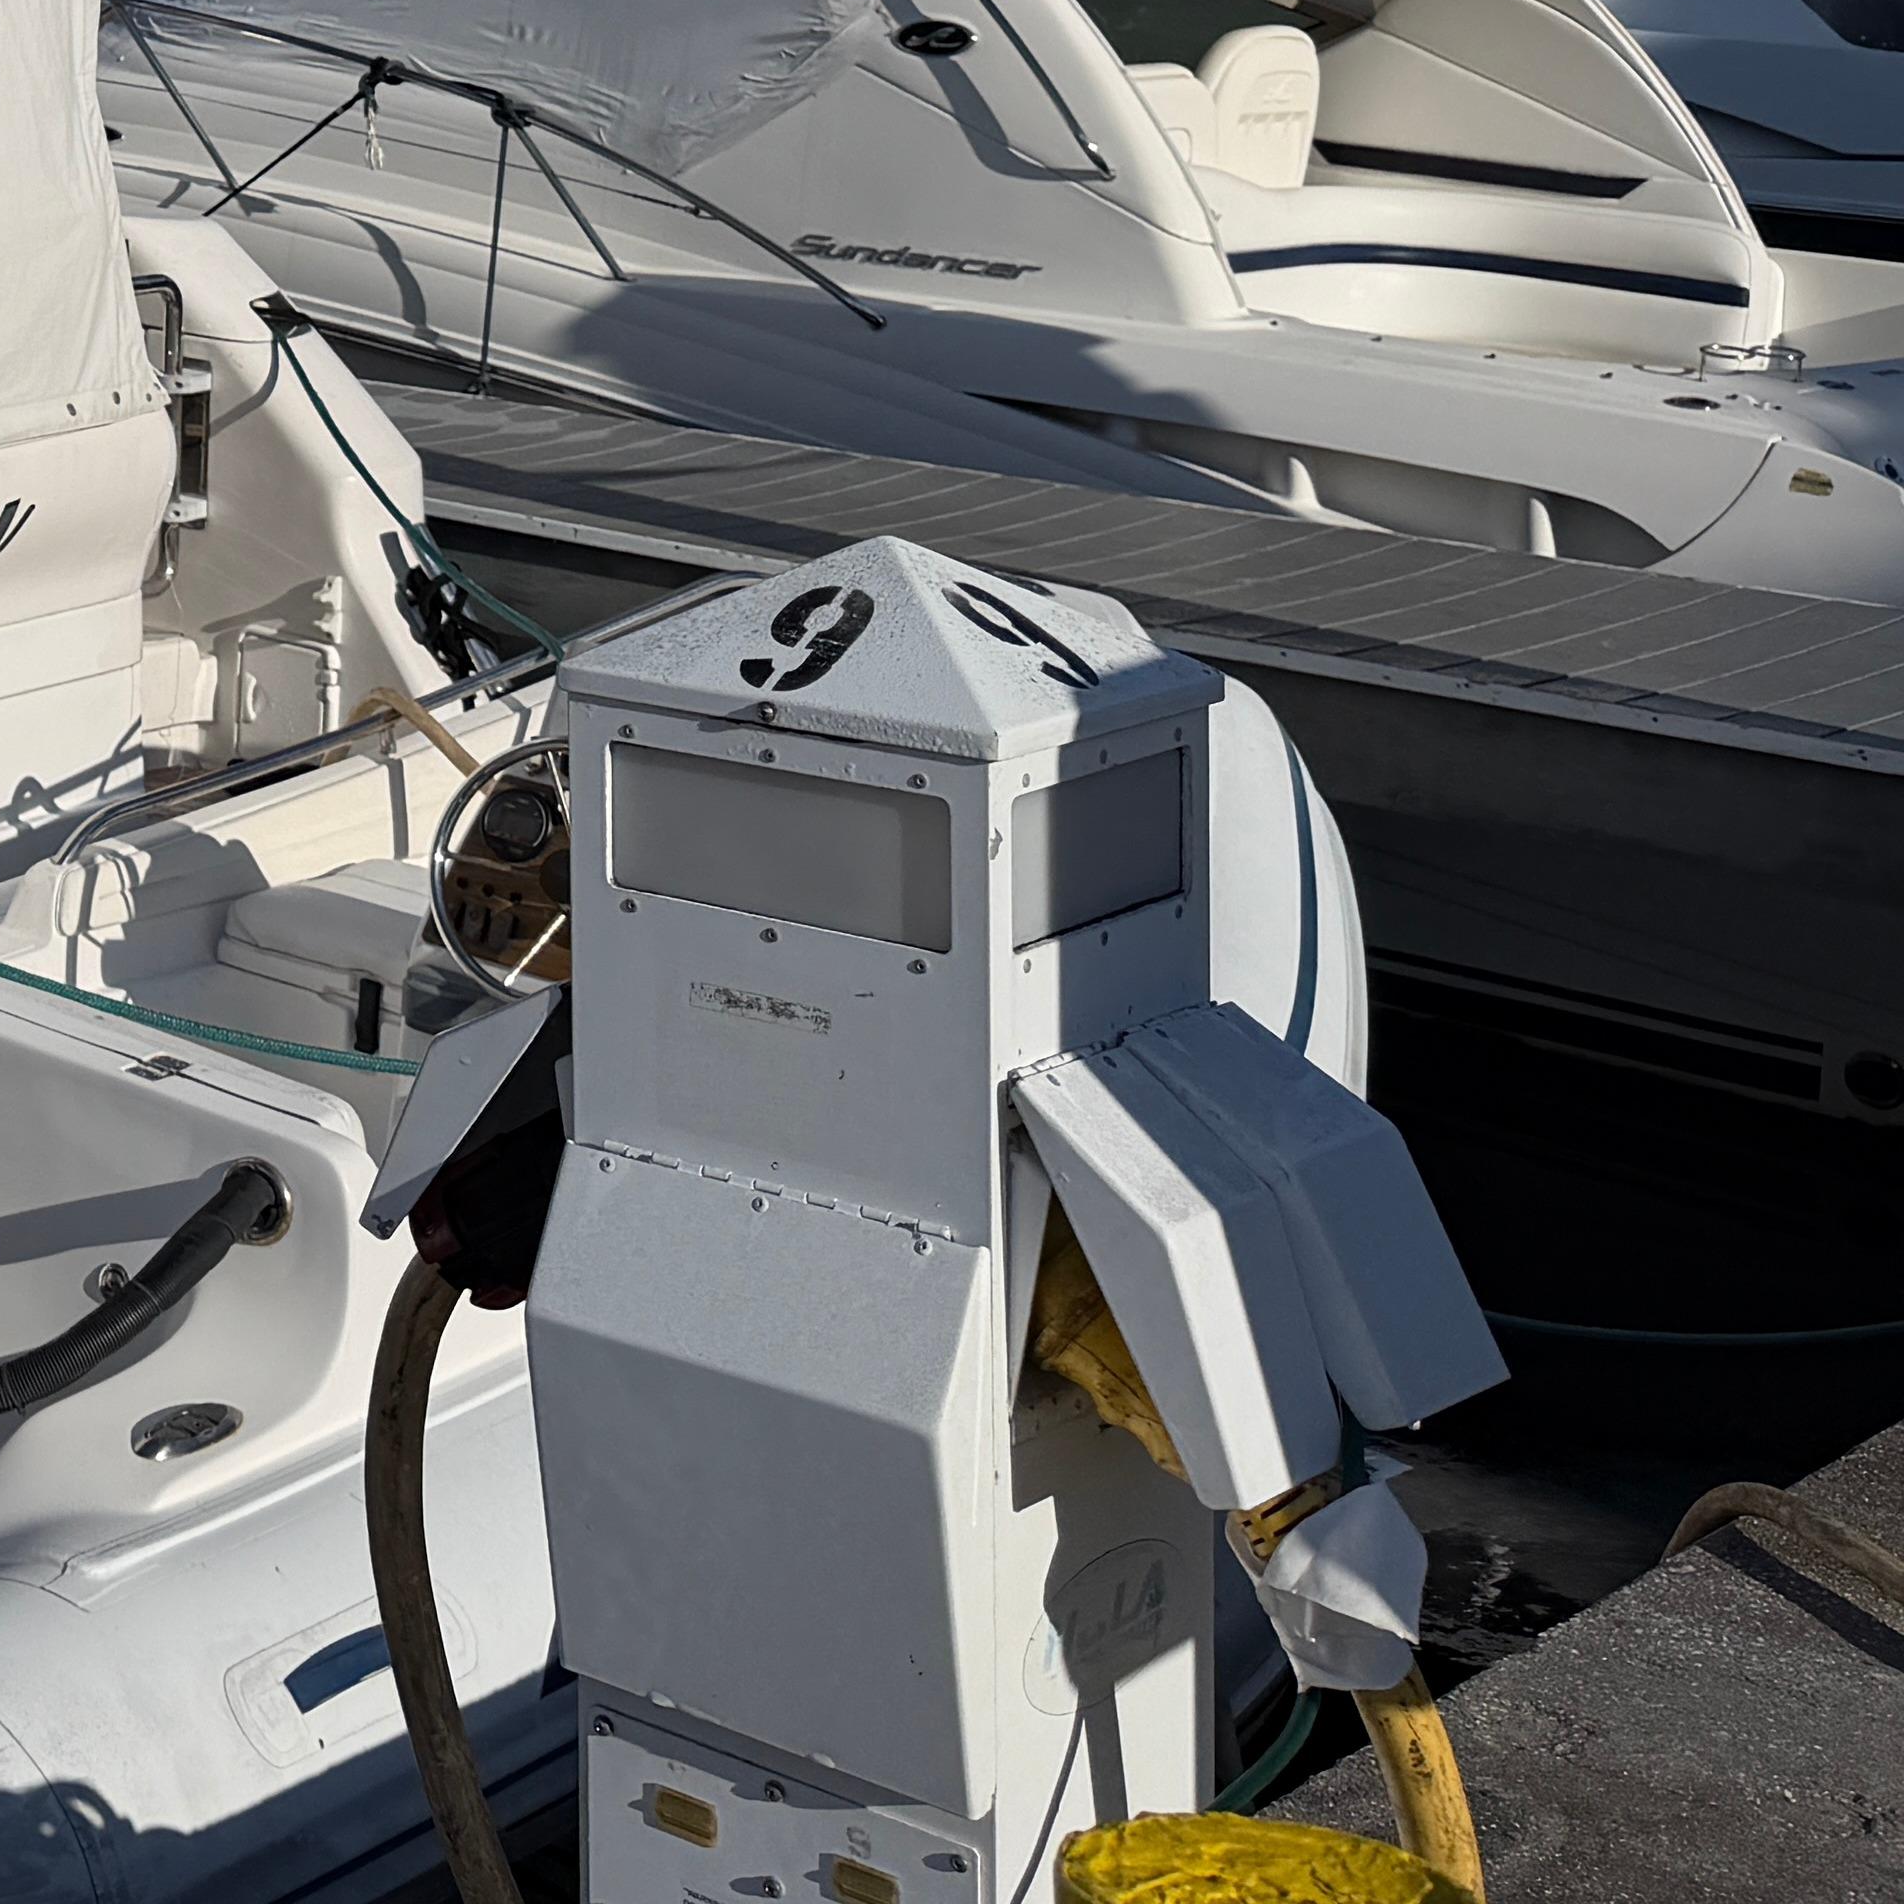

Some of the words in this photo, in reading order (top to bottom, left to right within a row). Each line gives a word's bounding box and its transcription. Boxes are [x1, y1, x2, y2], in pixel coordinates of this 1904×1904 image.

[789, 233, 1044, 281] Sundancer
[739, 584, 876, 692] 9
[941, 580, 1100, 690] 9
